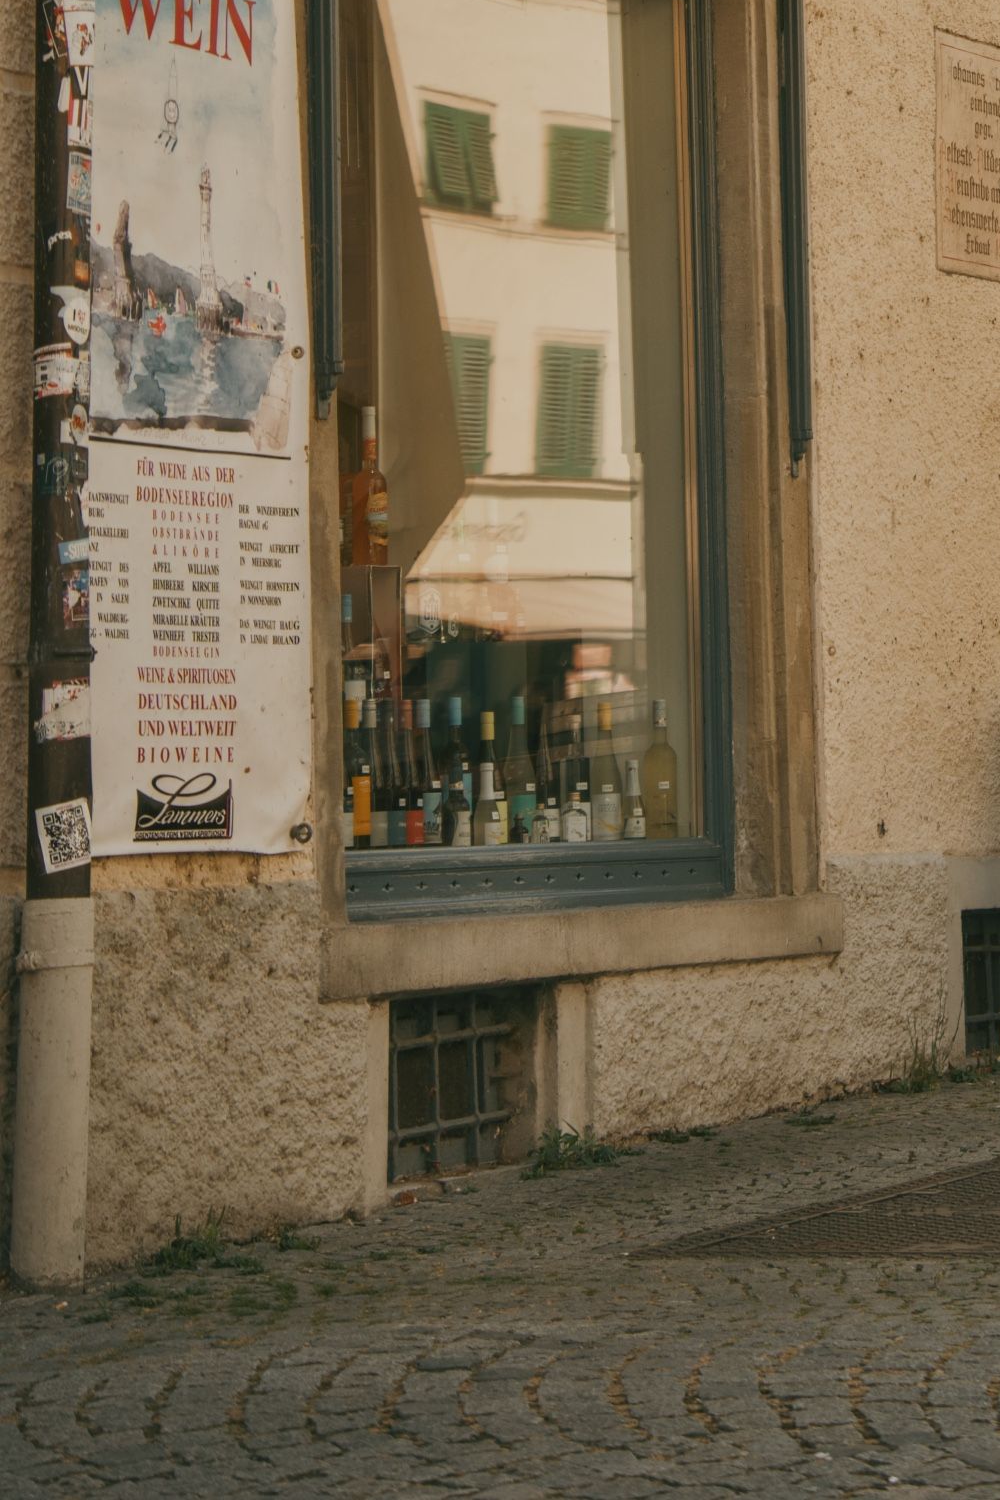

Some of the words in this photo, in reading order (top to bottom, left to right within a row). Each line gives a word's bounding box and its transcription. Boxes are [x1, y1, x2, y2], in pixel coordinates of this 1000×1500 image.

[974, 121, 993, 140] gegr.
[964, 233, 990, 256] Erbaut
[137, 456, 154, 477] FÜR
[159, 462, 187, 480] WEINE
[191, 465, 210, 482] AUS
[216, 467, 235, 483] DER
[136, 485, 234, 508] BODENSEEREGION
[152, 509, 220, 524] BODENSEE
[238, 504, 249, 514] DER
[256, 505, 300, 517] WINZERVEREIN
[238, 518, 260, 530] HAGNAU
[152, 525, 220, 542] OBSTBRÄNDE
[163, 544, 220, 558] LIKÖRE
[239, 541, 263, 552] WEINGUT
[269, 543, 300, 554] AUFRICHT
[119, 562, 129, 573] DES
[152, 562, 172, 573] APFEL
[187, 563, 220, 575] WILLIAMS
[239, 556, 245, 566] IN
[251, 557, 282, 568] MEERSBURG
[118, 578, 129, 588] VON
[152, 579, 184, 591] HIMBEERE
[192, 580, 220, 593] KIRSCHE
[239, 580, 263, 591] WEINGUT
[266, 581, 300, 592] HORNSTEIN
[111, 593, 129, 604] SALEM
[152, 596, 191, 609] ZWETSCHKE
[196, 598, 220, 611] QUITTE
[240, 594, 246, 605] IN
[152, 613, 188, 626] MIRABELLE
[190, 612, 220, 628] KRÄUTER
[239, 618, 250, 629] DAS
[253, 619, 276, 630] WEINGUT
[279, 620, 300, 631] HAUG
[104, 628, 130, 640] WALDSEE
[152, 630, 185, 641] WEINHEFE
[192, 631, 220, 643] TRESTER
[240, 634, 246, 644] IN
[250, 634, 268, 645] LINDAU
[272, 635, 301, 645] BIOLAND
[152, 646, 200, 657] BODENSEE
[203, 646, 220, 658] GIN
[137, 667, 166, 683] WEINE
[167, 670, 175, 683] &
[177, 668, 236, 685] SPIRITUOSEN
[138, 694, 237, 711] DEUTSCHLAND
[138, 720, 165, 737] UND
[168, 720, 237, 737] WELTWEIT
[137, 747, 234, 763] BIOWEINE
[137, 772, 226, 828] Lammers
